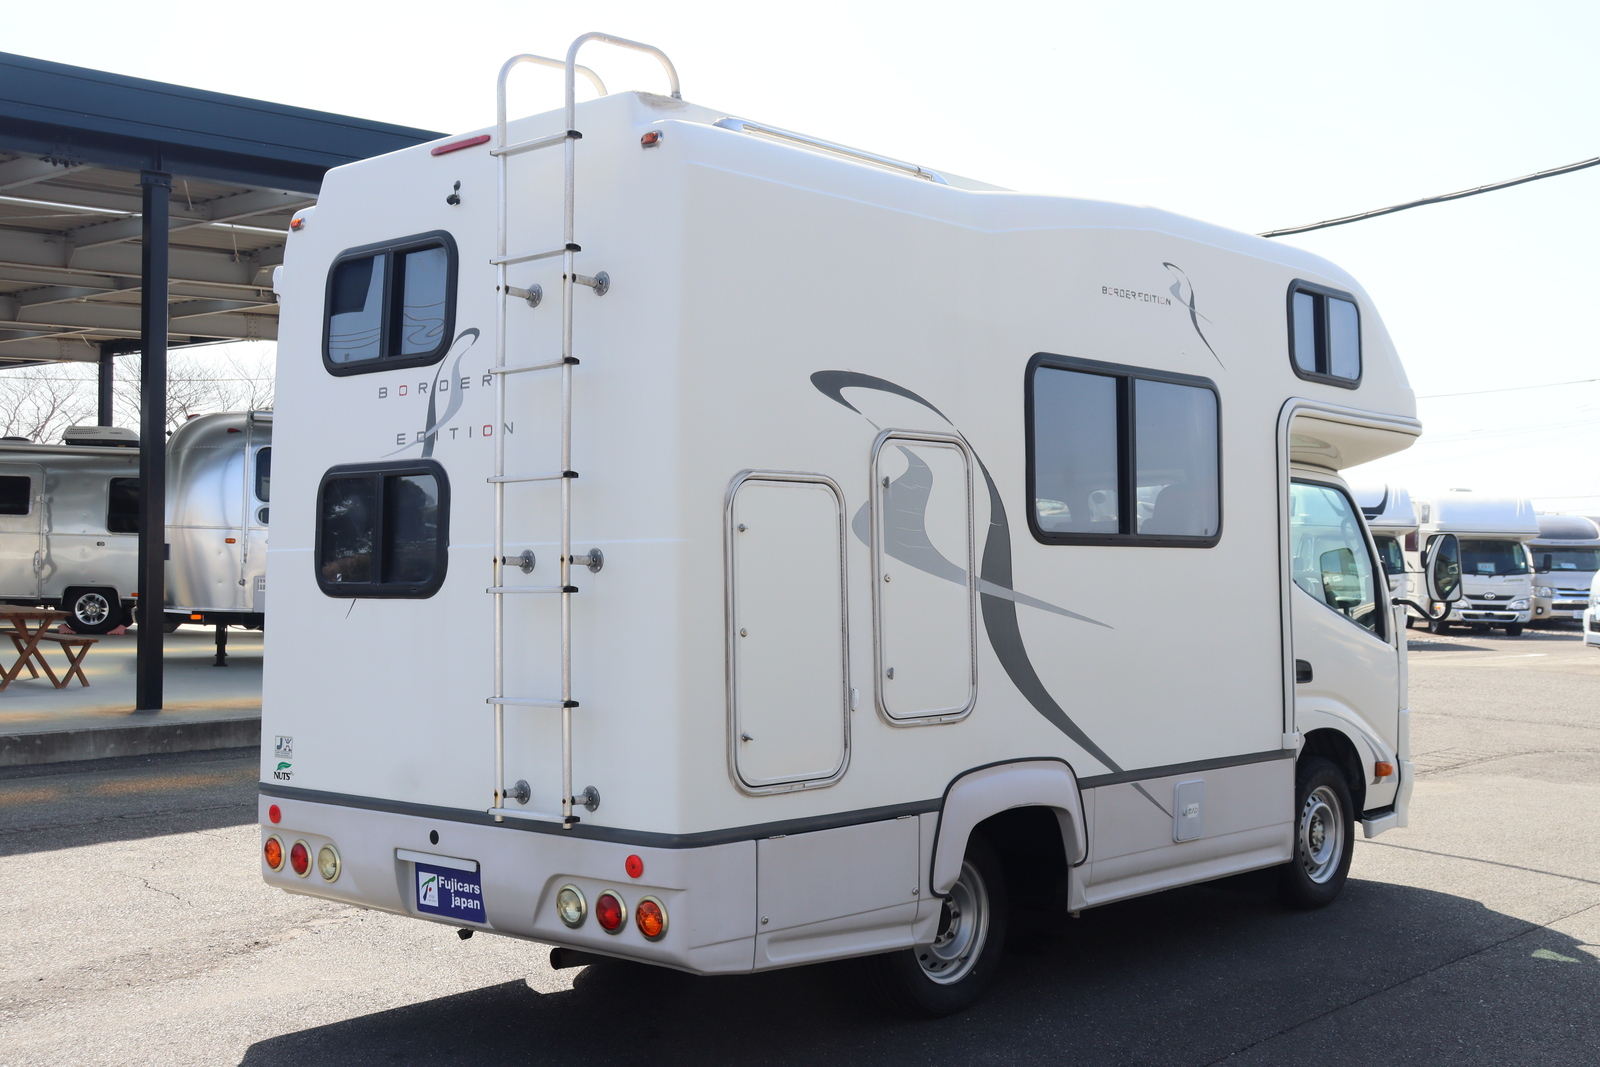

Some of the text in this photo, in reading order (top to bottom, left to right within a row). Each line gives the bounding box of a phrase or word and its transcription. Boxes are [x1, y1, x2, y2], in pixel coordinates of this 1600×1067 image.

[378, 374, 493, 399] BORDER
[396, 421, 514, 445] EDITION
[273, 771, 291, 781] NUTS
[438, 876, 481, 895] Fujicars
[451, 893, 481, 910] japan
